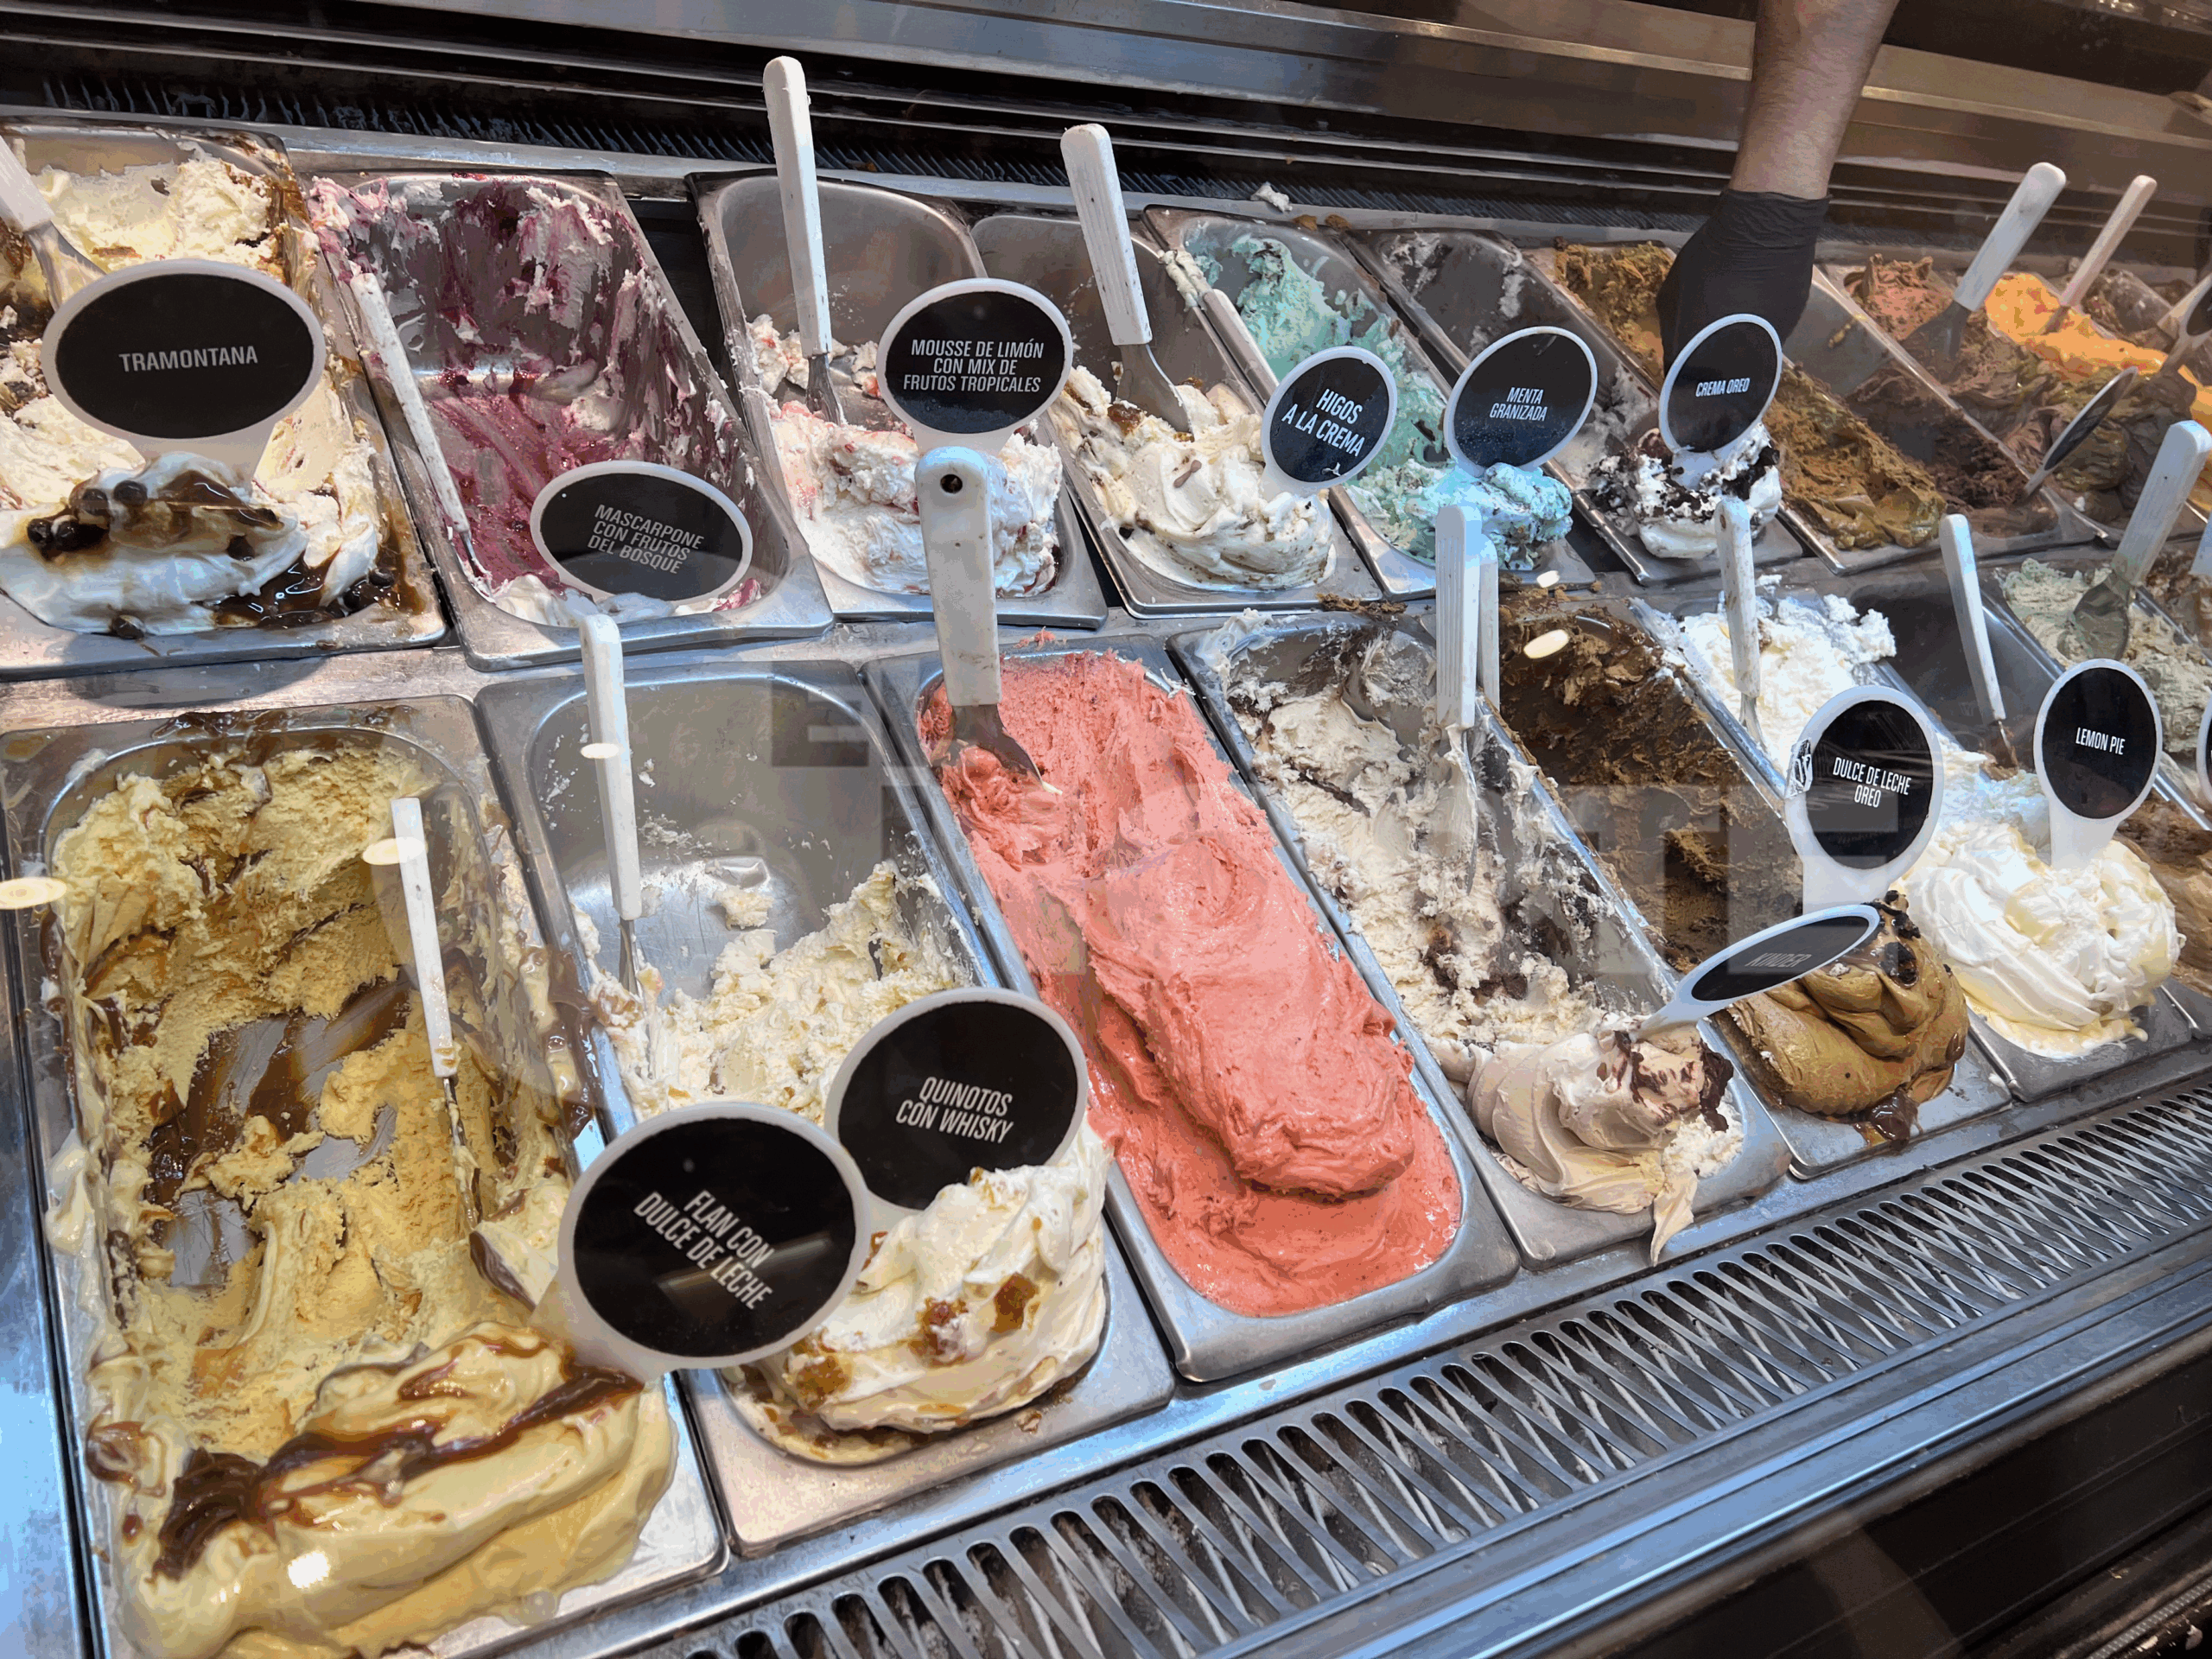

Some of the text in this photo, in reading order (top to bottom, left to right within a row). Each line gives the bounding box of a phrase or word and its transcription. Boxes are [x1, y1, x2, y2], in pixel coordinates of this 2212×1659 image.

[118, 346, 258, 372] TRAMONTANA
[911, 338, 1045, 359] MOUSSE DE LIMÓN
[933, 357, 1018, 375] CON MIX DE
[903, 374, 1041, 392] FRUTOS TROPICALES
[1506, 386, 1544, 404] MENTA
[1695, 377, 1751, 397] CREMA OREO
[1315, 388, 1363, 424] HIGOS
[1489, 402, 1548, 422] GRANIZADA
[1281, 404, 1365, 457] A LA CREMA
[593, 520, 690, 561] CON FRUTOS
[594, 504, 705, 550] MASCARPONE
[588, 535, 683, 575] DEL BOSQUE
[2075, 727, 2126, 755] LEMON PIE
[1832, 756, 1866, 783] DULCE
[1865, 766, 1881, 786] DE
[1880, 770, 1912, 796] LECHE
[1853, 784, 1882, 808] OREO
[1744, 952, 1813, 968] KINDER
[918, 1076, 1014, 1117] QUINOTOS
[895, 1099, 1014, 1144] CON WHISKY
[683, 1189, 775, 1269] FLAN CON
[632, 1191, 773, 1310] DULCE DE LECHE
